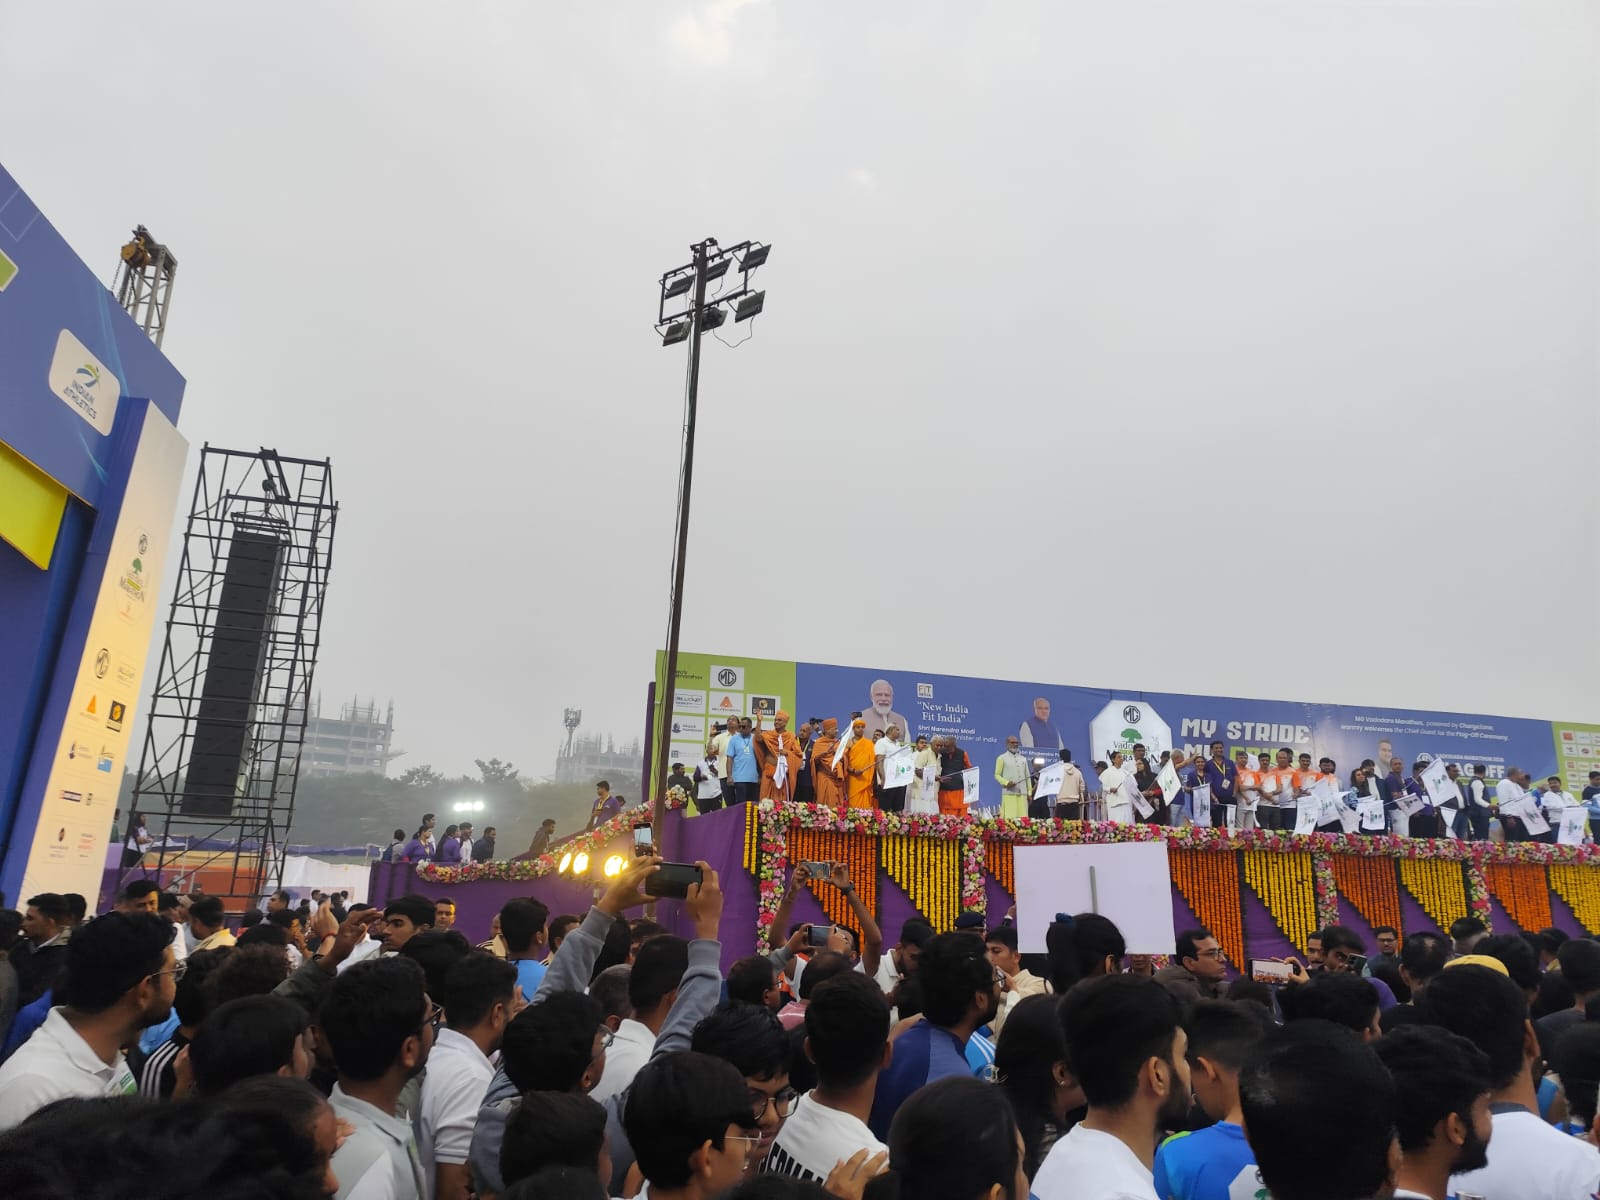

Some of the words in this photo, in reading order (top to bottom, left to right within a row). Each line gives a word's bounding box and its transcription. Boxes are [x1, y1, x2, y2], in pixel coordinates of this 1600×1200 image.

[718, 669, 737, 687] MG
[922, 712, 935, 721] Fit
[945, 704, 969, 714] India
[1123, 705, 1141, 724] MG
[1181, 718, 1217, 739] MY
[1226, 721, 1310, 744] STRIDE
[1113, 740, 1150, 753] Vadoa
